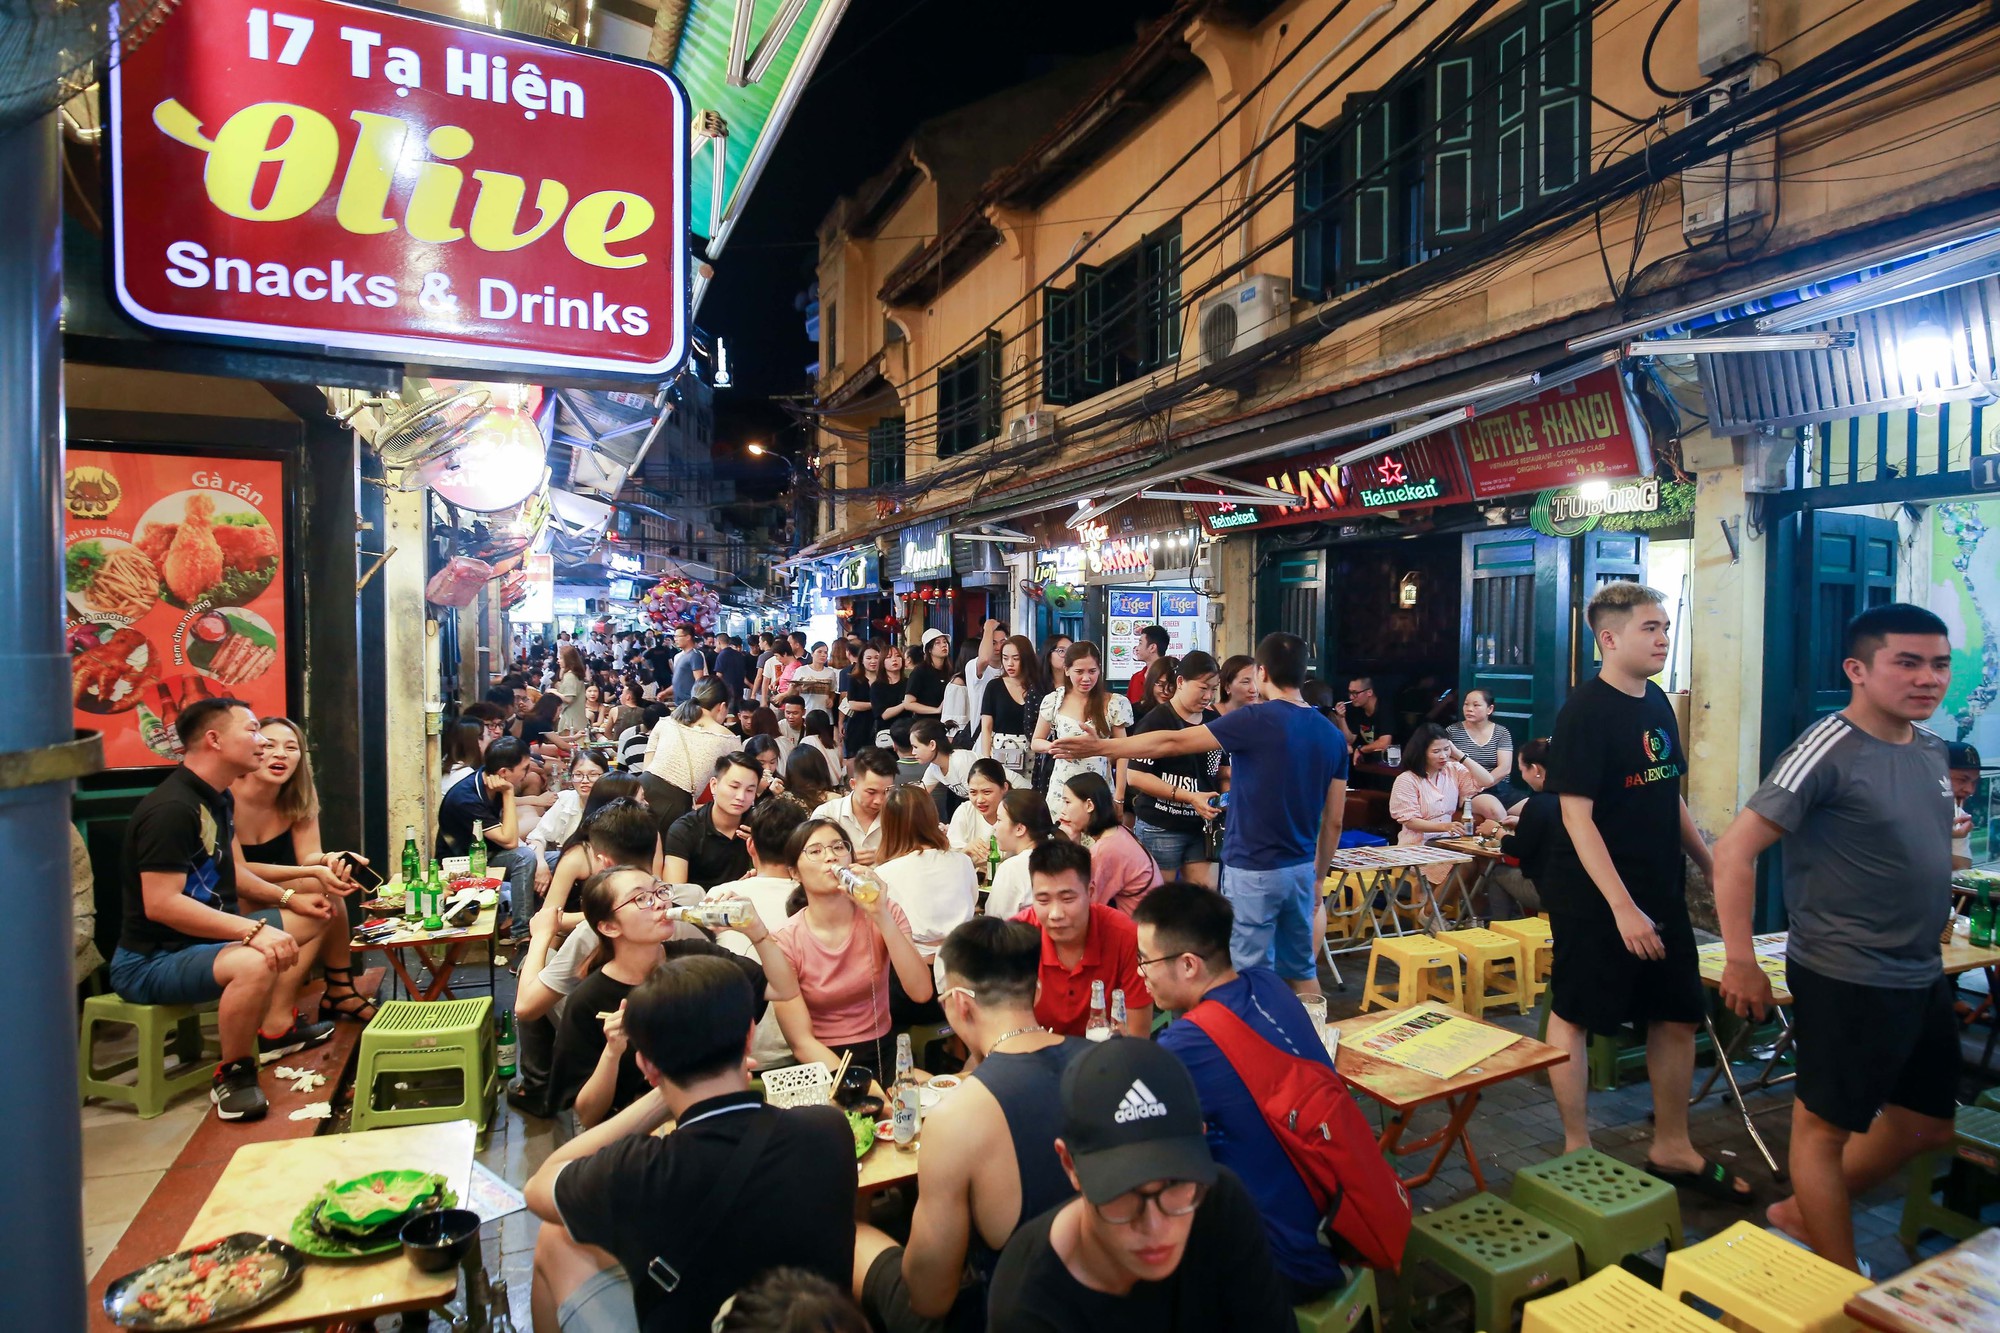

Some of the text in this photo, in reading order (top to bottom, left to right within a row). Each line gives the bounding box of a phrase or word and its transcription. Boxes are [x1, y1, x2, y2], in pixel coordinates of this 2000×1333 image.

[246, 8, 585, 120] 17 Tạ Hiện
[152, 98, 655, 269] Olive
[165, 240, 649, 336] Snacks & Drinks
[1465, 392, 1620, 462] LITTLE HANOI
[1520, 454, 1552, 464] RESTAURANT
[1557, 448, 1586, 458] COOKING
[1586, 443, 1606, 452] CLASS
[1517, 464, 1543, 474] ORIGINAL
[1547, 460, 1564, 469] SINCE
[1576, 461, 1606, 476] 9-12
[1983, 459, 2000, 484] 1
[192, 471, 263, 506] Gà rán
[1360, 478, 1438, 507] Heineken
[1552, 480, 1659, 522] TUBORG
[1209, 508, 1257, 529] Heineken
[65, 531, 78, 543] oai
[1120, 597, 1151, 614] Tiger
[1168, 597, 1196, 614] Tiger
[79, 613, 93, 624] gà
[172, 622, 186, 643] chua
[172, 645, 184, 666] Nem
[1155, 802, 1168, 812] Mode
[1114, 1102, 1167, 1124] adidas
